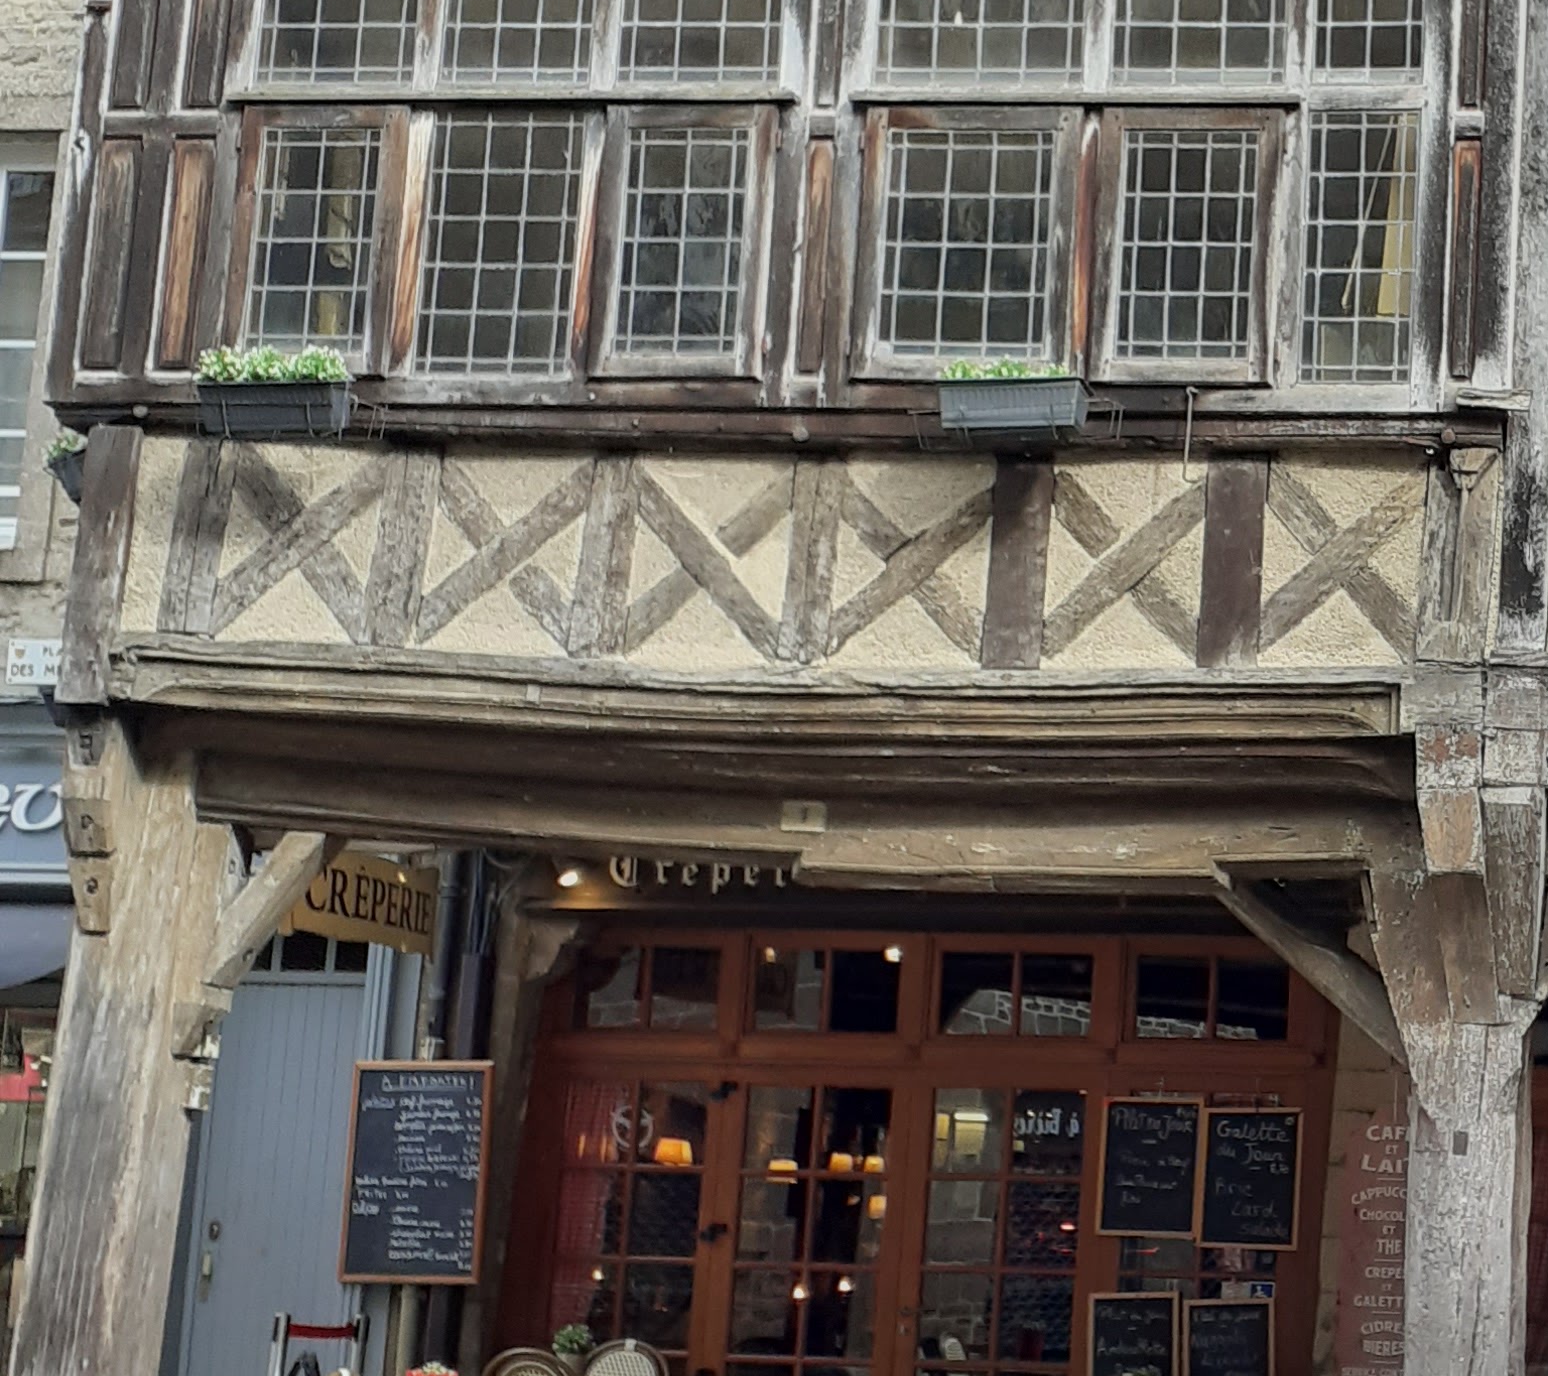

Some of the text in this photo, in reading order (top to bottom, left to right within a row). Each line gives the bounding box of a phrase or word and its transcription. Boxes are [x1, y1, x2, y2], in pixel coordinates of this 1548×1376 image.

[10, 663, 34, 677] DES
[1385, 1144, 1398, 1155] ET
[1360, 1154, 1408, 1174] LAI
[1382, 1225, 1396, 1235] ET
